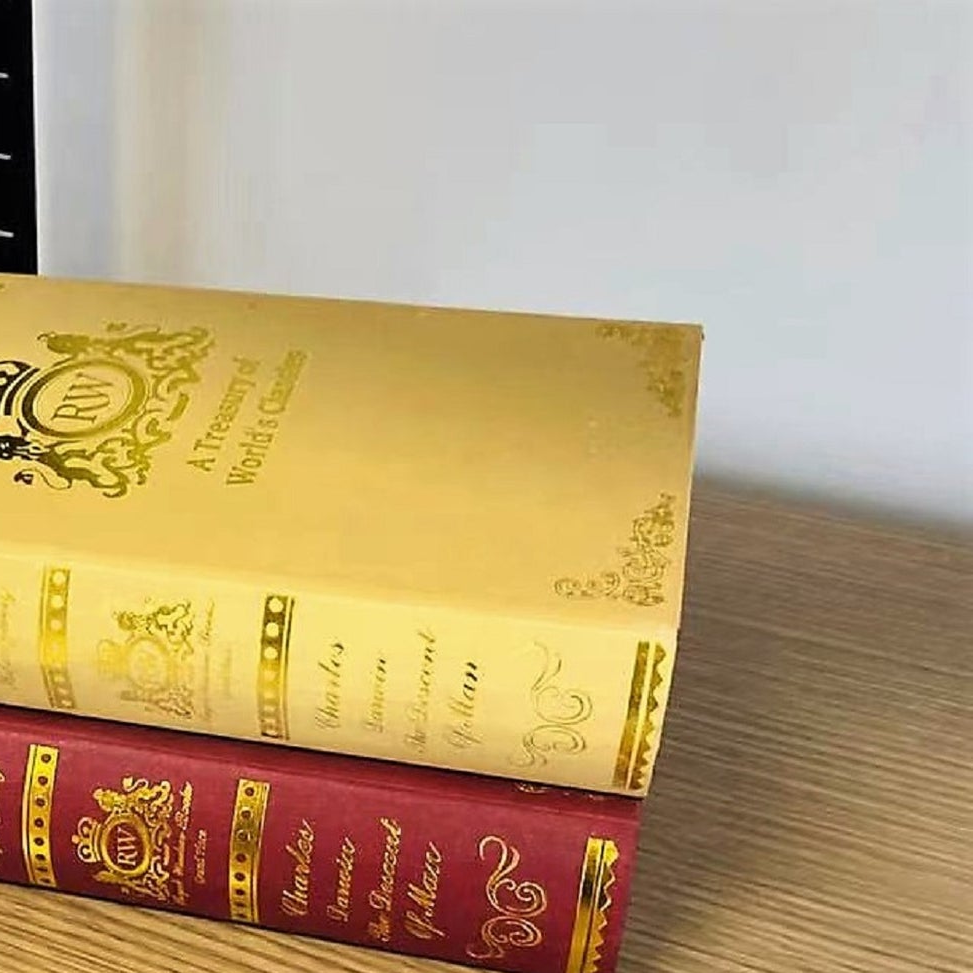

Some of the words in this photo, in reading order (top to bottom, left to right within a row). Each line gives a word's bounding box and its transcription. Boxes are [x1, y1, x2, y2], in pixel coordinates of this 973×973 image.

[50, 371, 114, 424] RW
[186, 456, 216, 473] A
[313, 634, 345, 730] Charles
[280, 818, 316, 917] Charles
